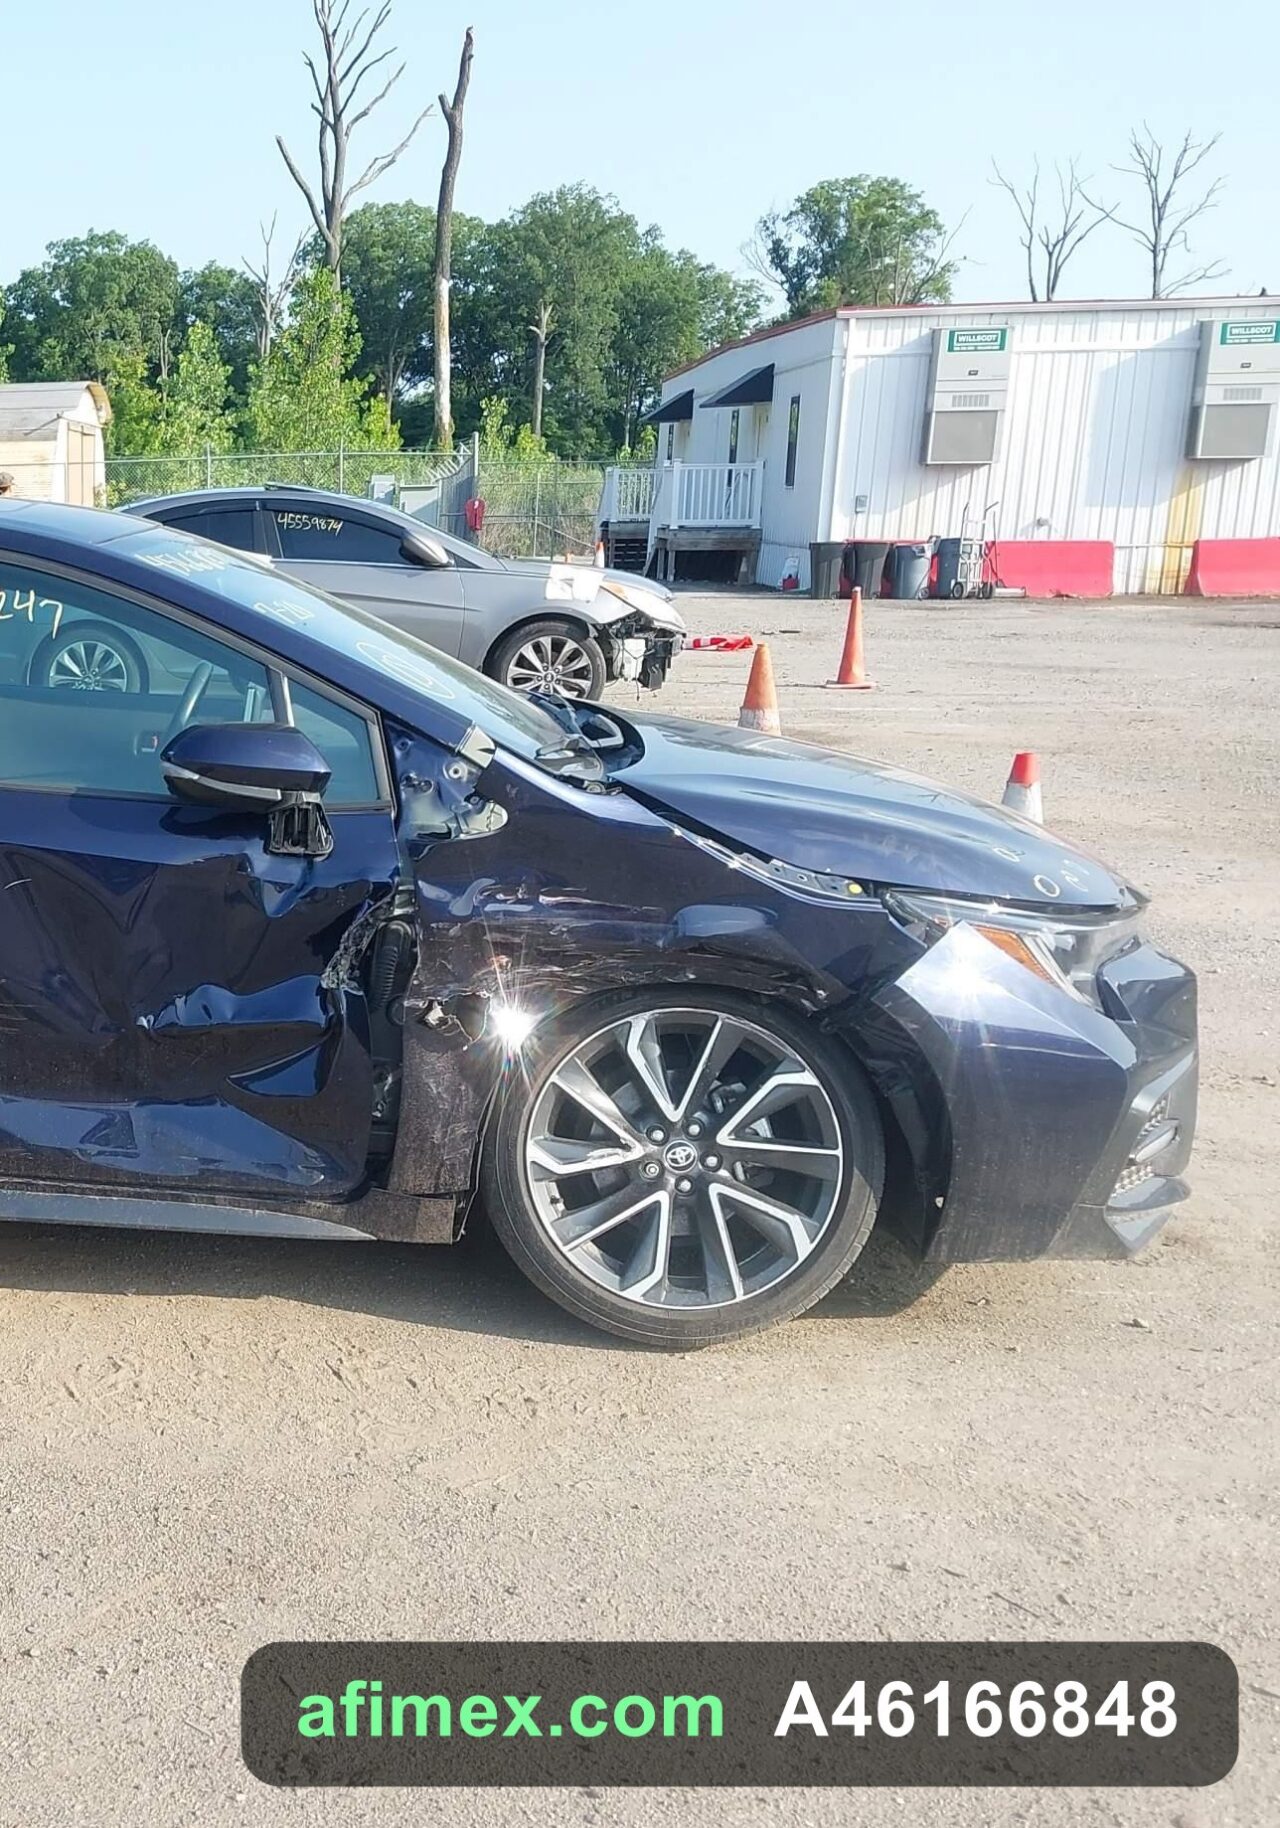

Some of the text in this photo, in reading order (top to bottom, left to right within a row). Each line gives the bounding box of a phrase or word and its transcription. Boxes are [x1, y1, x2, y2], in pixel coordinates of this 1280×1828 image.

[1231, 326, 1272, 335] WILLSCOT
[958, 334, 998, 342] WILLSCOT
[277, 512, 343, 536] 45559874
